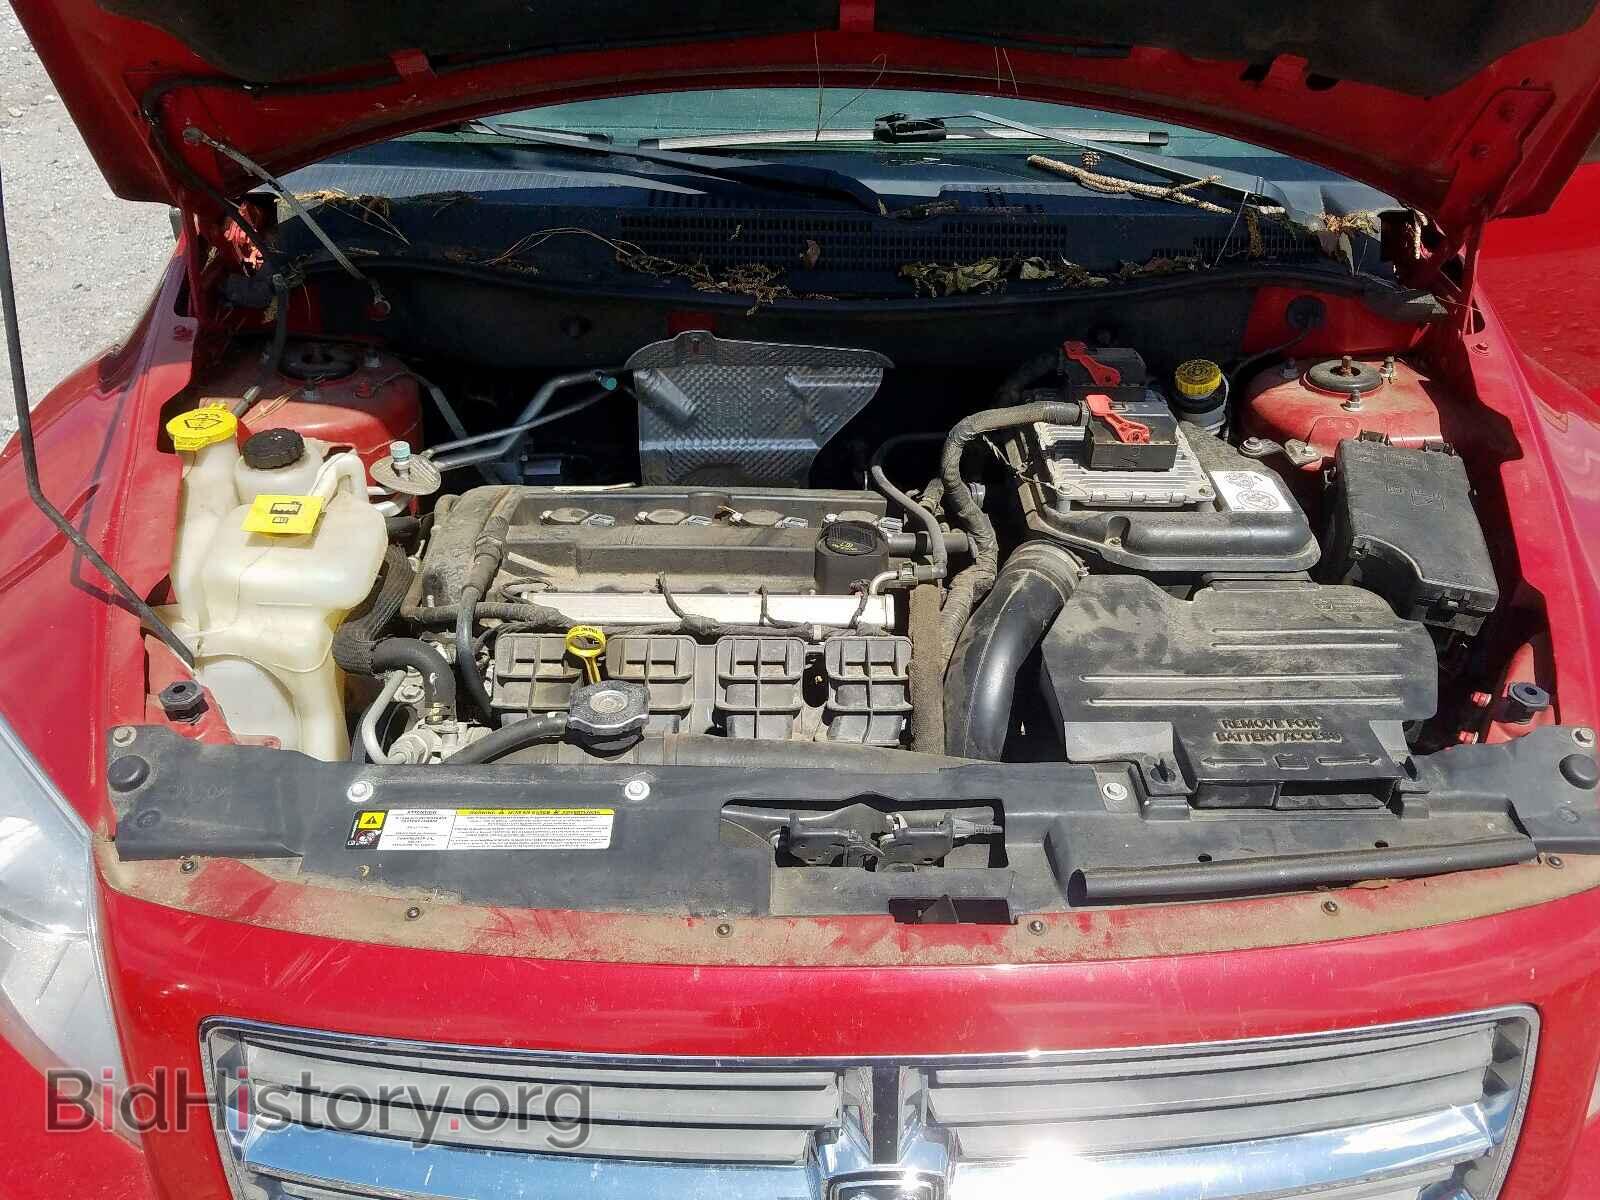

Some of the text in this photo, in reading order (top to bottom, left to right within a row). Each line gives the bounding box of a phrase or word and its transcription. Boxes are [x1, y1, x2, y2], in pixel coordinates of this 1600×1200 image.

[1220, 719, 1320, 729] REMOVE FOR
[1215, 731, 1342, 742] BATTERY ACCESS
